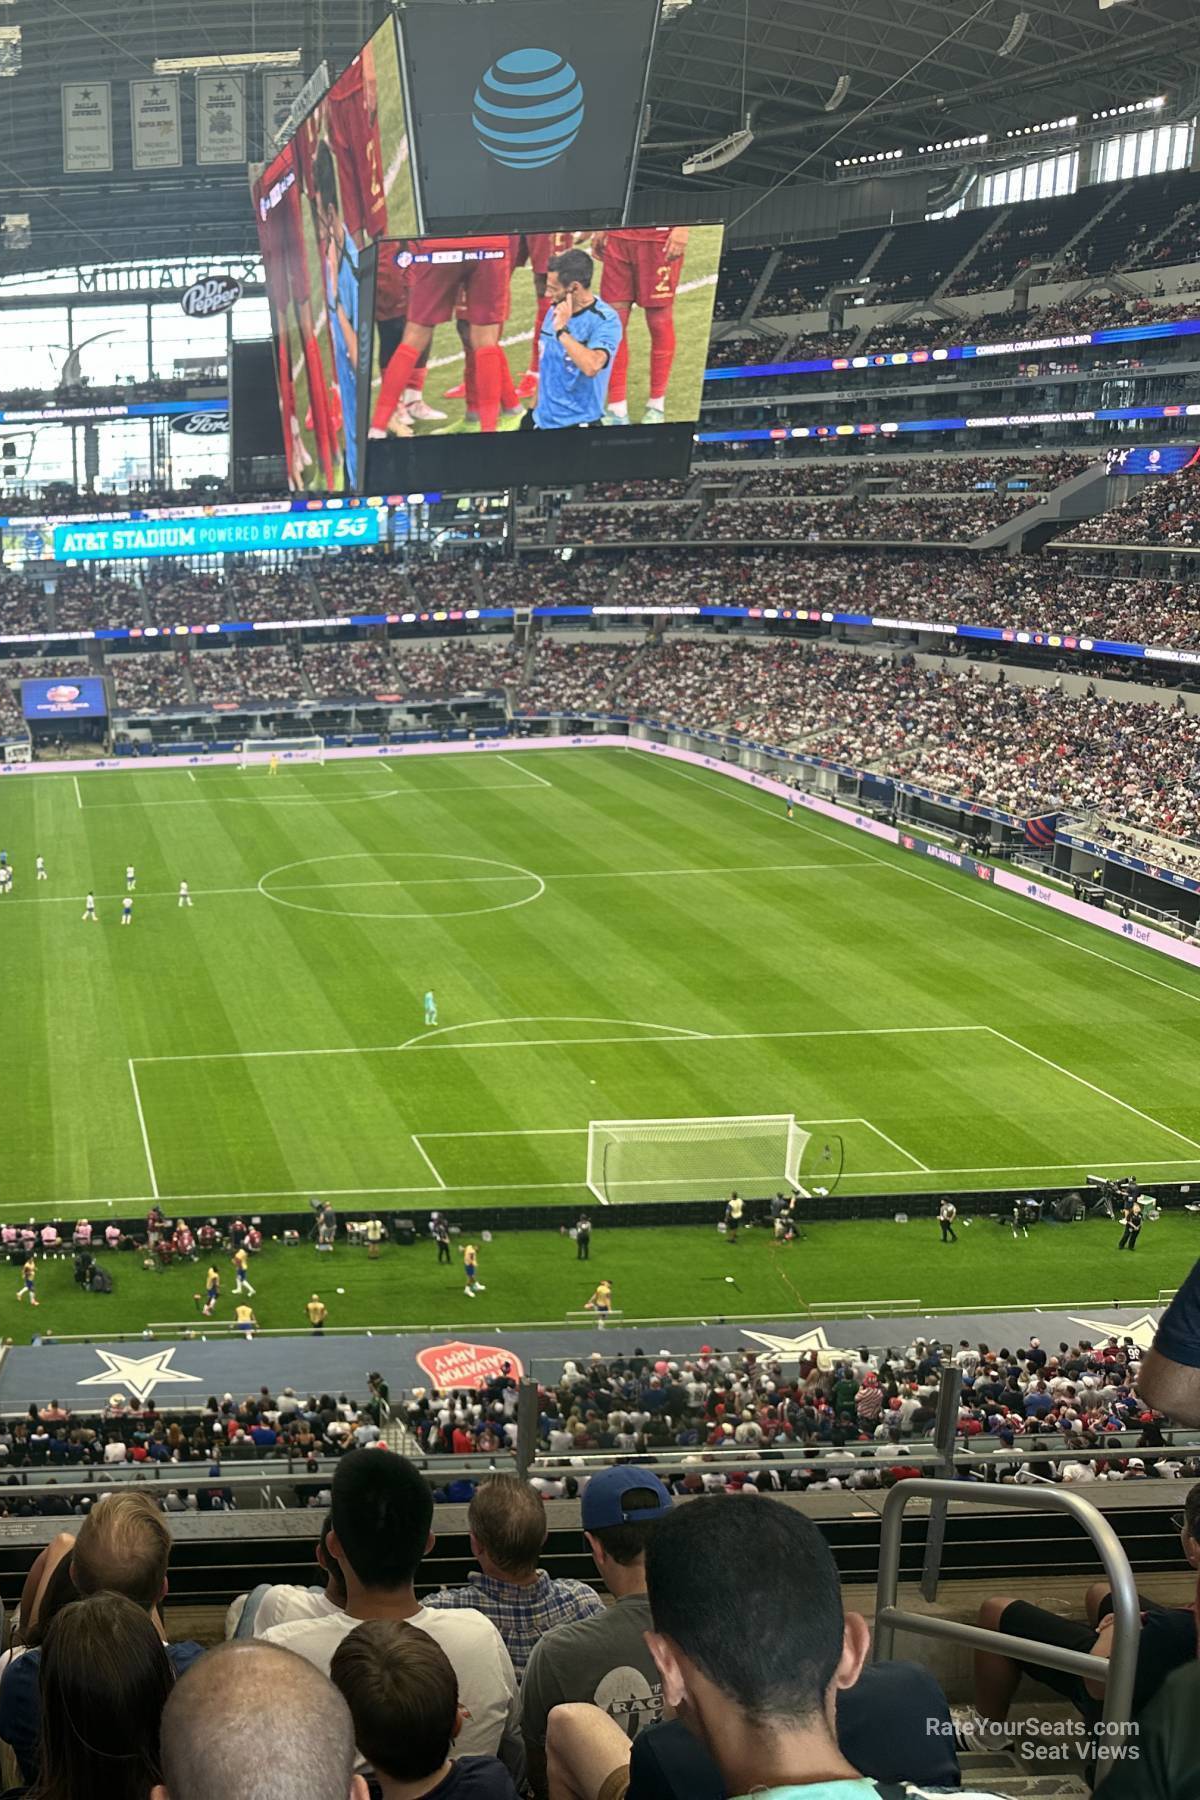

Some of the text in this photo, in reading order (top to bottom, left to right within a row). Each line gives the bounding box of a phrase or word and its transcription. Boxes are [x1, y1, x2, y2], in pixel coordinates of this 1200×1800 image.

[205, 280, 227, 297] Dr
[655, 266, 671, 291] 2
[184, 285, 238, 315] Pepper
[63, 517, 368, 552] AT&T STADIUM POWERED BY AT&T 5G
[927, 844, 962, 867] ARLINGTON
[435, 1346, 477, 1371] ARMY
